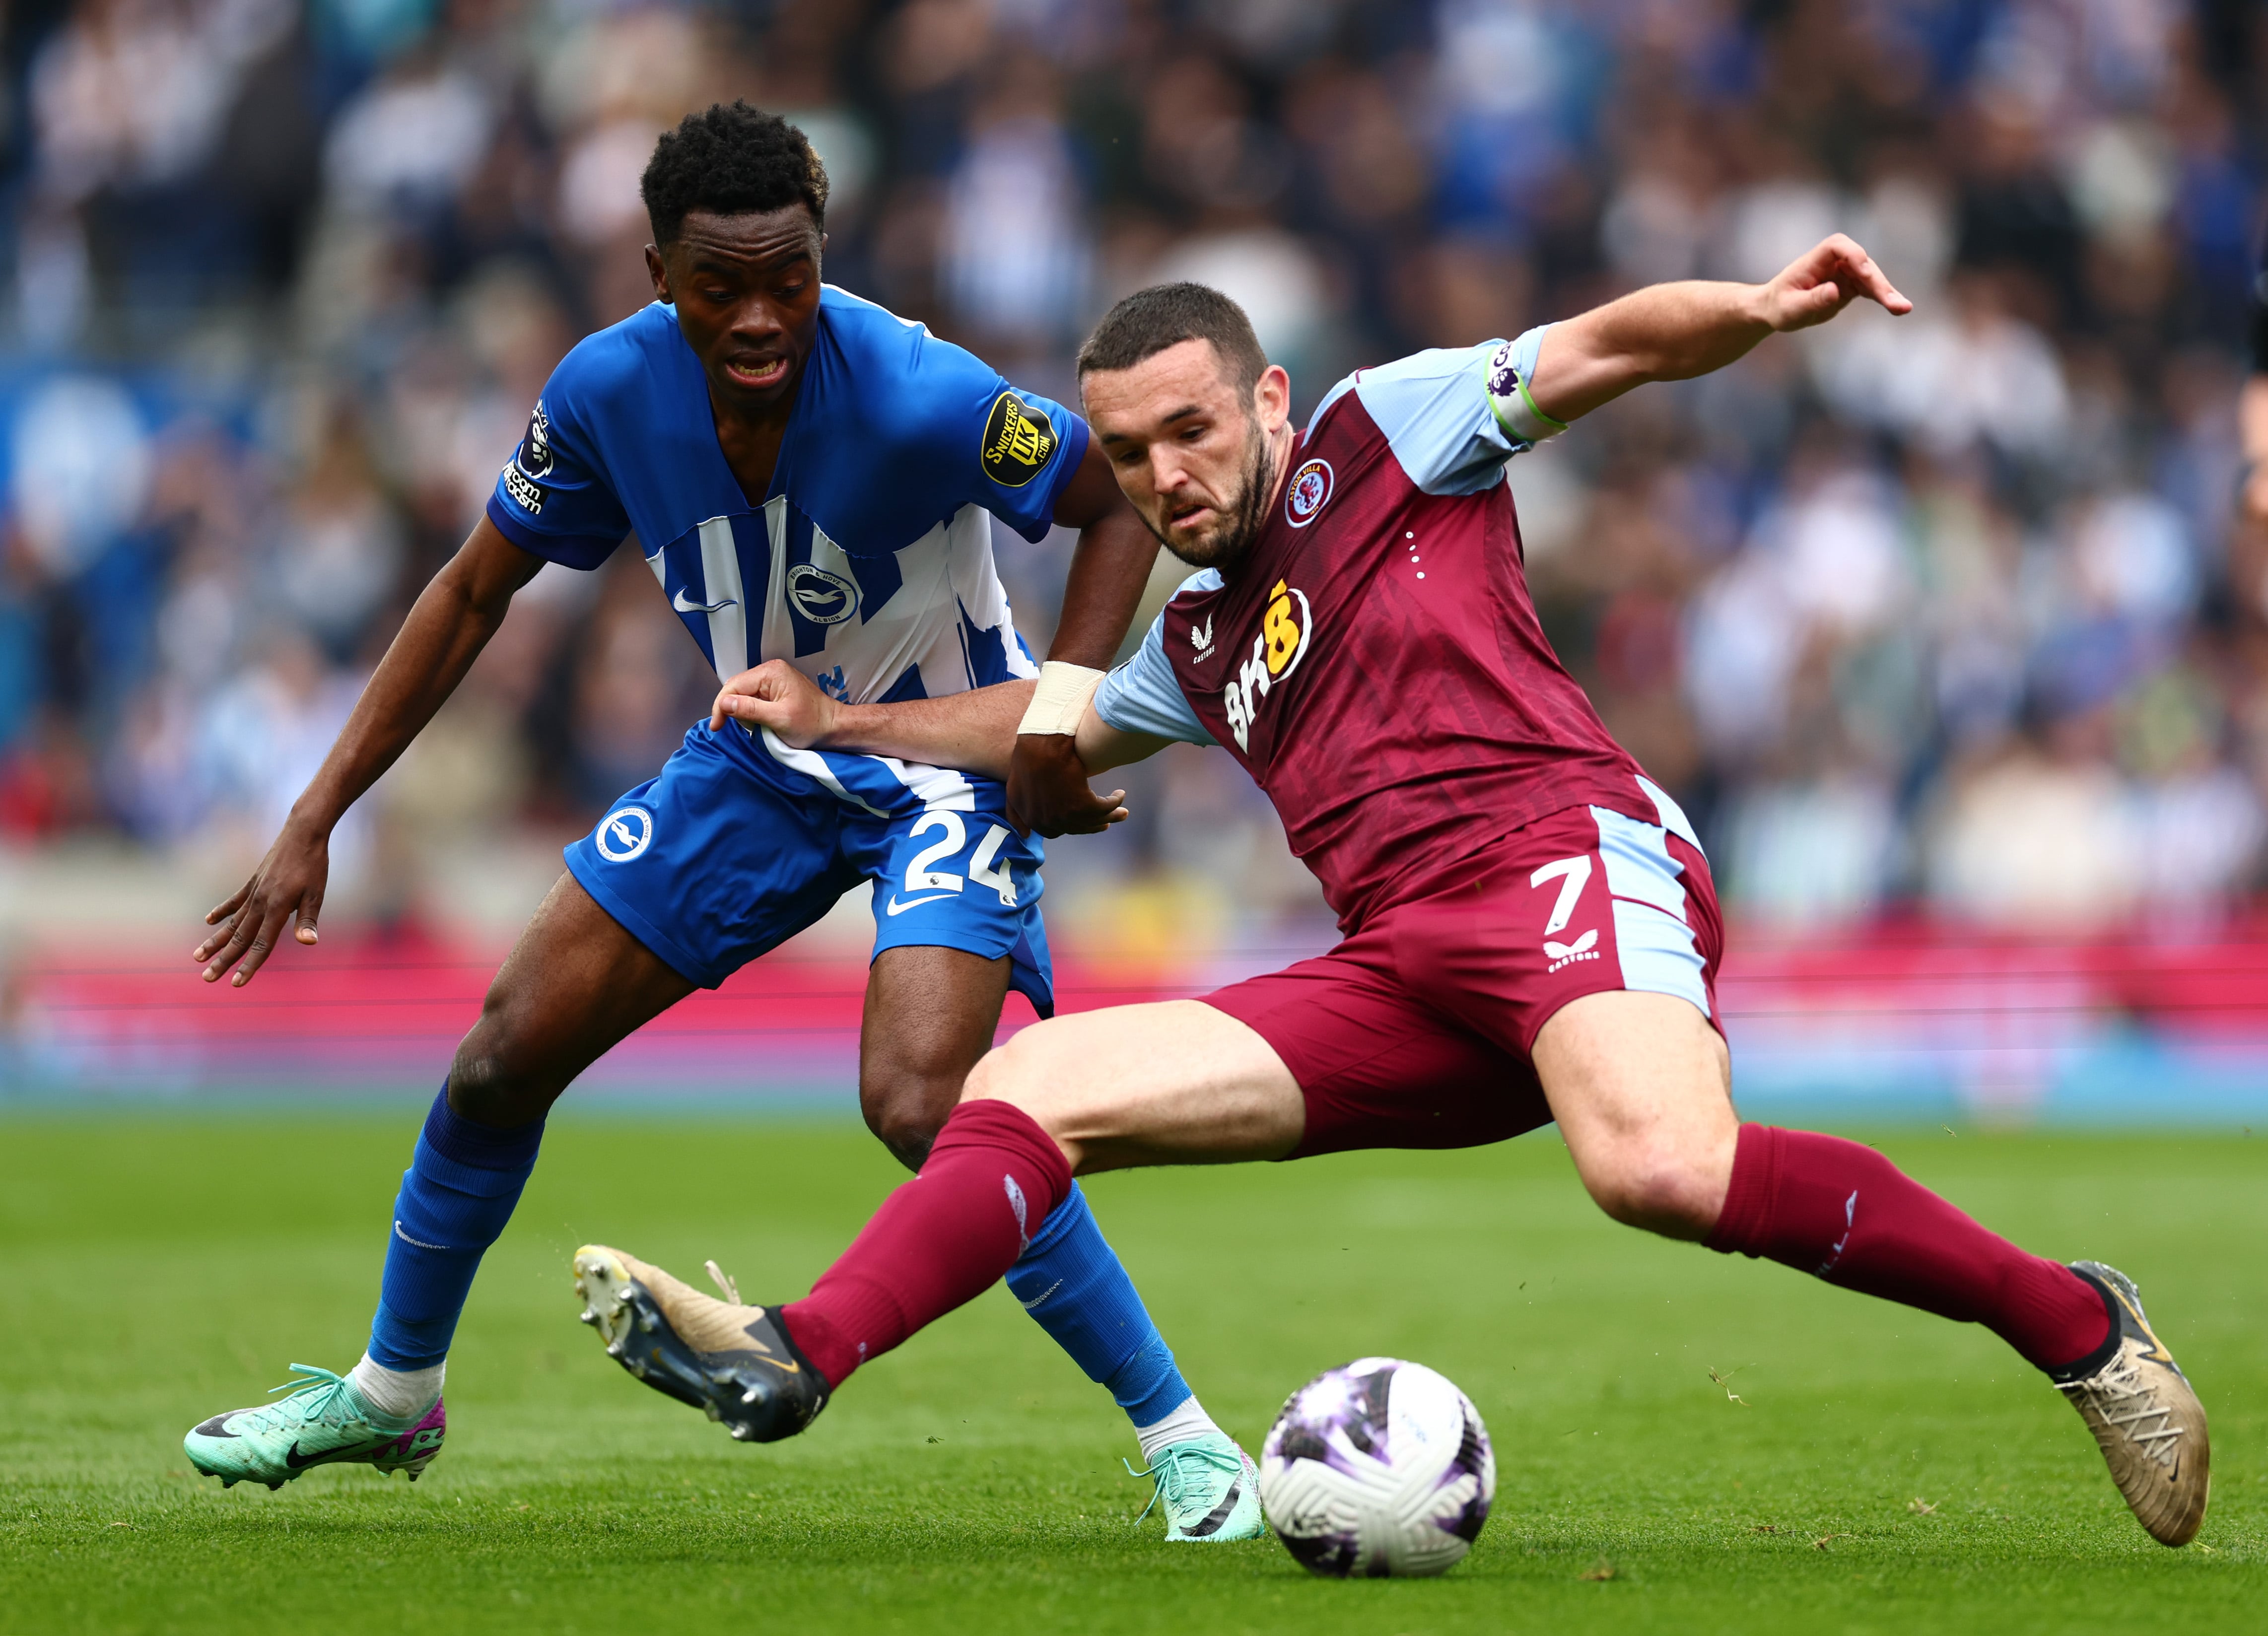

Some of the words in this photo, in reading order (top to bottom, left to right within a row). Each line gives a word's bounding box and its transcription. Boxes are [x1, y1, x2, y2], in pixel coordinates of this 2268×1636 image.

[985, 399, 1019, 464] SNICKERS
[1012, 422, 1035, 461] UK
[1037, 435, 1050, 463] .COM
[506, 477, 542, 515] racism
[1289, 475, 1302, 501] ASTON
[1303, 465, 1320, 475] VILLA
[790, 567, 814, 580] BRIGHTON
[823, 575, 841, 585] HOVE
[1193, 645, 1215, 664] CASTORE
[623, 809, 646, 818] BRIGHTON
[599, 843, 614, 859] ALBION
[904, 810, 1018, 907] 24
[1530, 854, 1592, 936] 7
